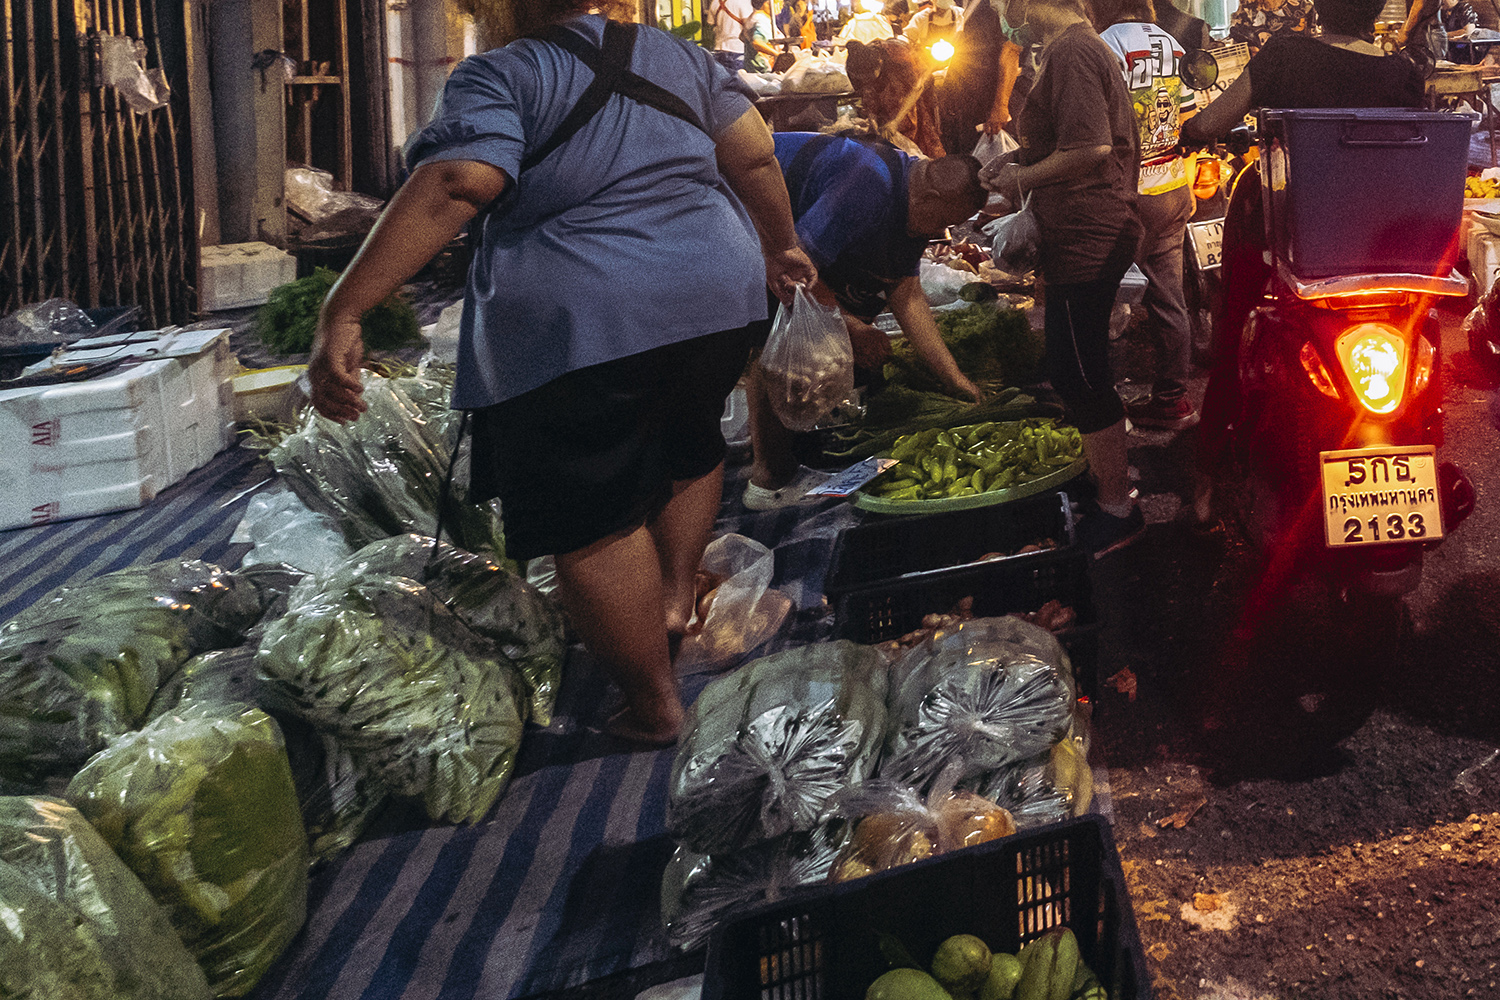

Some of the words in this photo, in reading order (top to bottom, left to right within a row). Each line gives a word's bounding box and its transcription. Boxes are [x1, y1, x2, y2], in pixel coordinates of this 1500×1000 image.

[1329, 488, 1435, 515] กรุงเทพมหานคร
[1343, 513, 1427, 544] 2133
